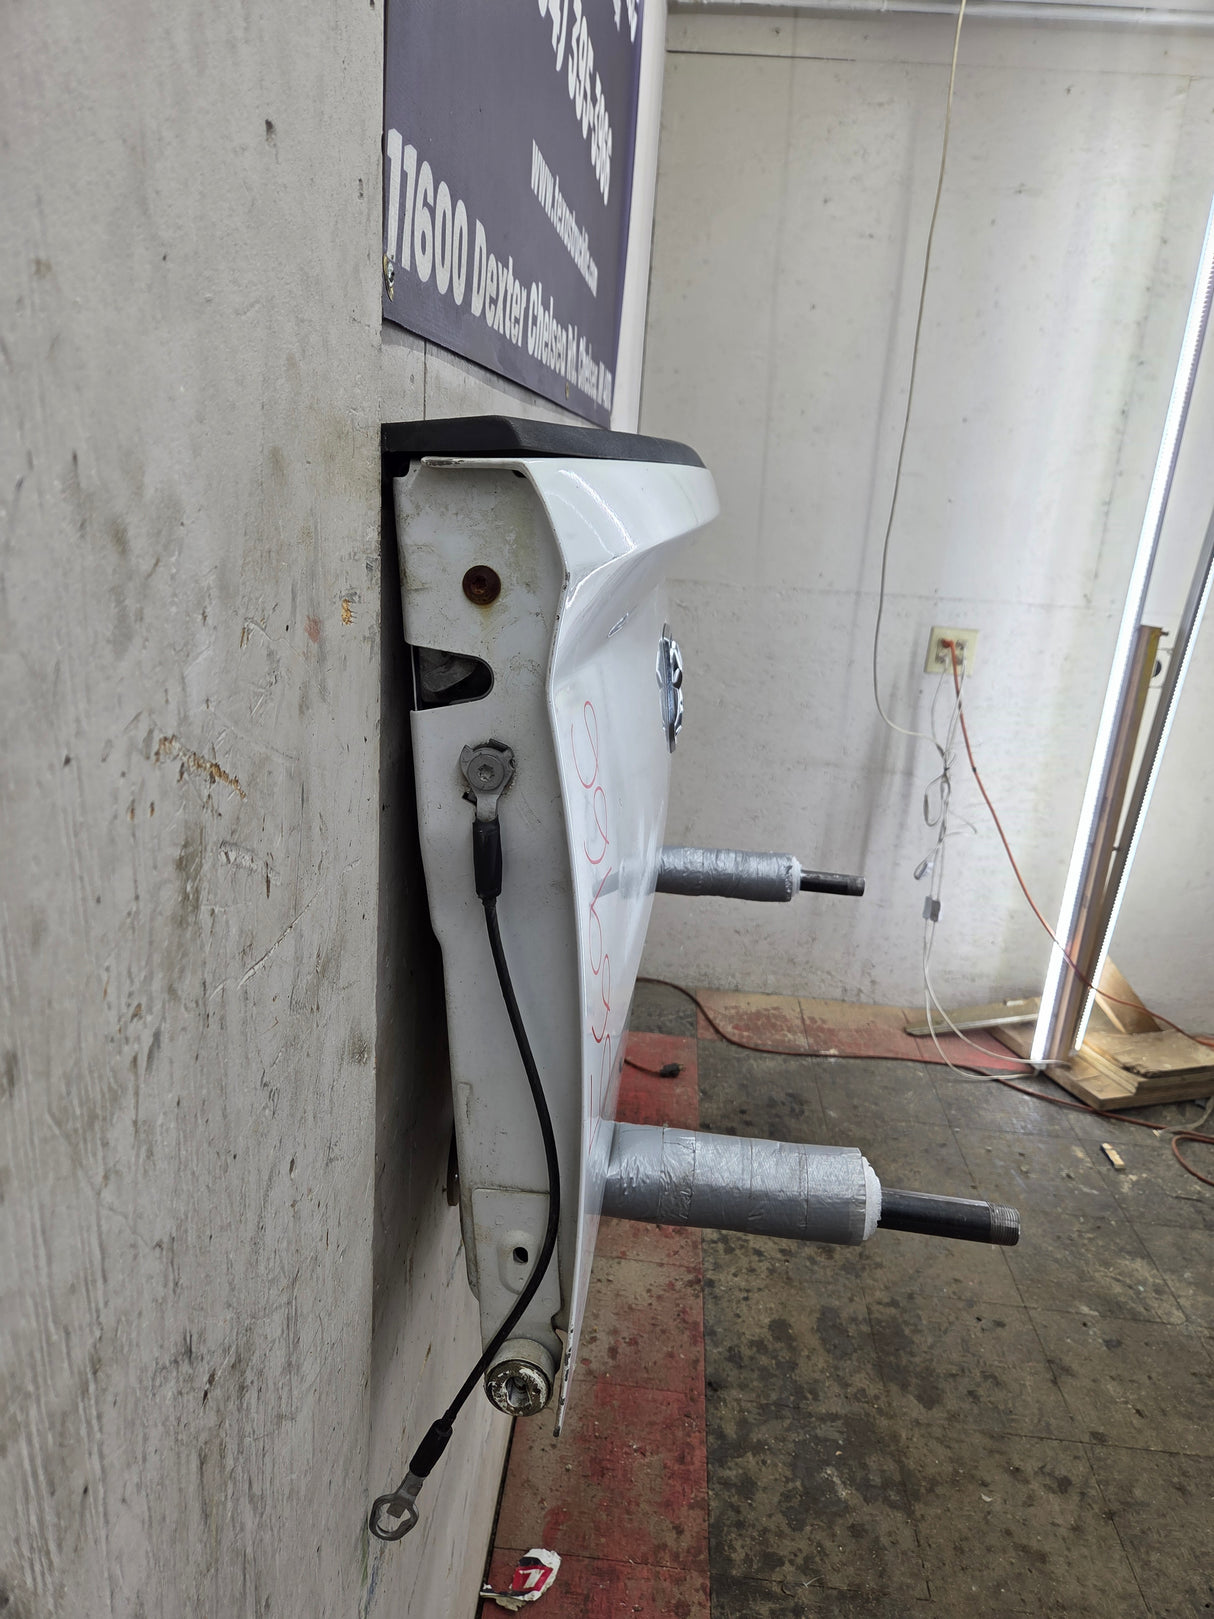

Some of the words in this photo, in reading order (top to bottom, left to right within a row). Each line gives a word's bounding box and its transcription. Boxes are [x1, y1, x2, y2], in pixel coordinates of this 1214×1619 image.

[386, 128, 468, 305] 11600
[471, 218, 527, 348] Dexter
[527, 281, 567, 377] Chelsea
